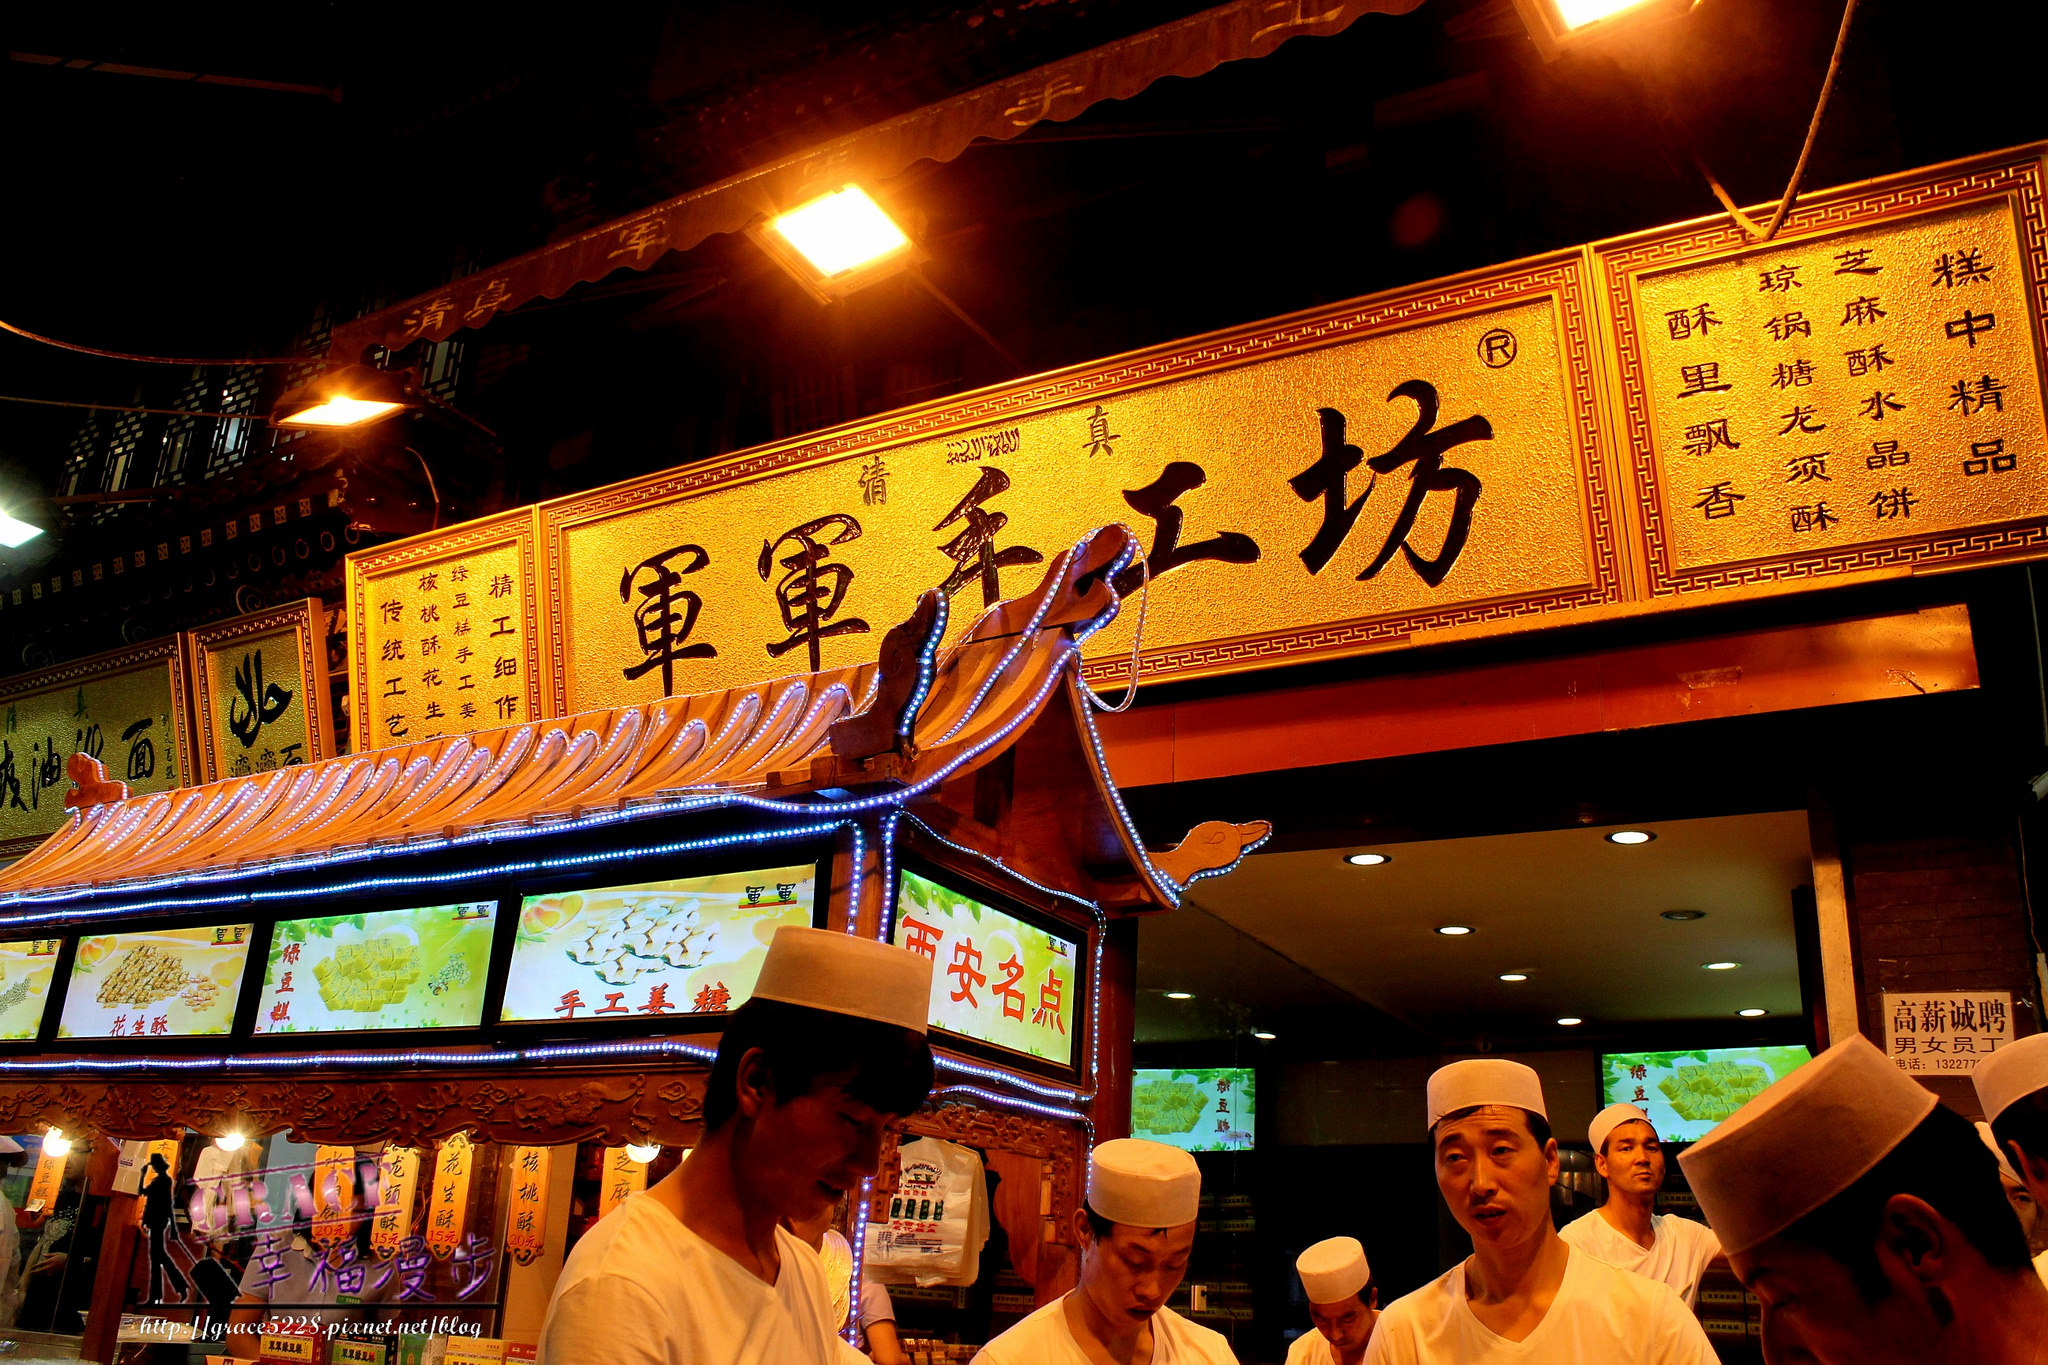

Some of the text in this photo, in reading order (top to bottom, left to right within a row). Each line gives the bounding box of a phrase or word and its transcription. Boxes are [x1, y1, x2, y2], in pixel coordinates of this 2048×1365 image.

[1665, 302, 1746, 521] 酥里飘香
[1759, 264, 1839, 533] 琼锅糖龙须酥
[1833, 249, 1919, 520] 芝麻酥水晶饼
[1931, 247, 2018, 477] 糕中精品
[858, 456, 890, 506] 清
[1083, 405, 1121, 458] 真
[620, 379, 1494, 697] 軍軍手工坊
[380, 599, 408, 737] 传统工艺
[418, 573, 445, 739] 核桃酥花生
[451, 565, 477, 735] 绿豆糕手工姜
[489, 574, 518, 719] 精工细作
[554, 981, 731, 1020] 手工姜糖
[902, 915, 1065, 1035] 西安名点
[1891, 998, 2007, 1034] 高薪诚聘
[110, 1014, 168, 1037] 花生酥
[1894, 1036, 2004, 1054] 男女员工
[428, 1230, 459, 1244] 15元
[435, 1151, 462, 1230] 花生酥
[516, 1151, 540, 1232] 核桃酥
[509, 1234, 538, 1249] 20元
